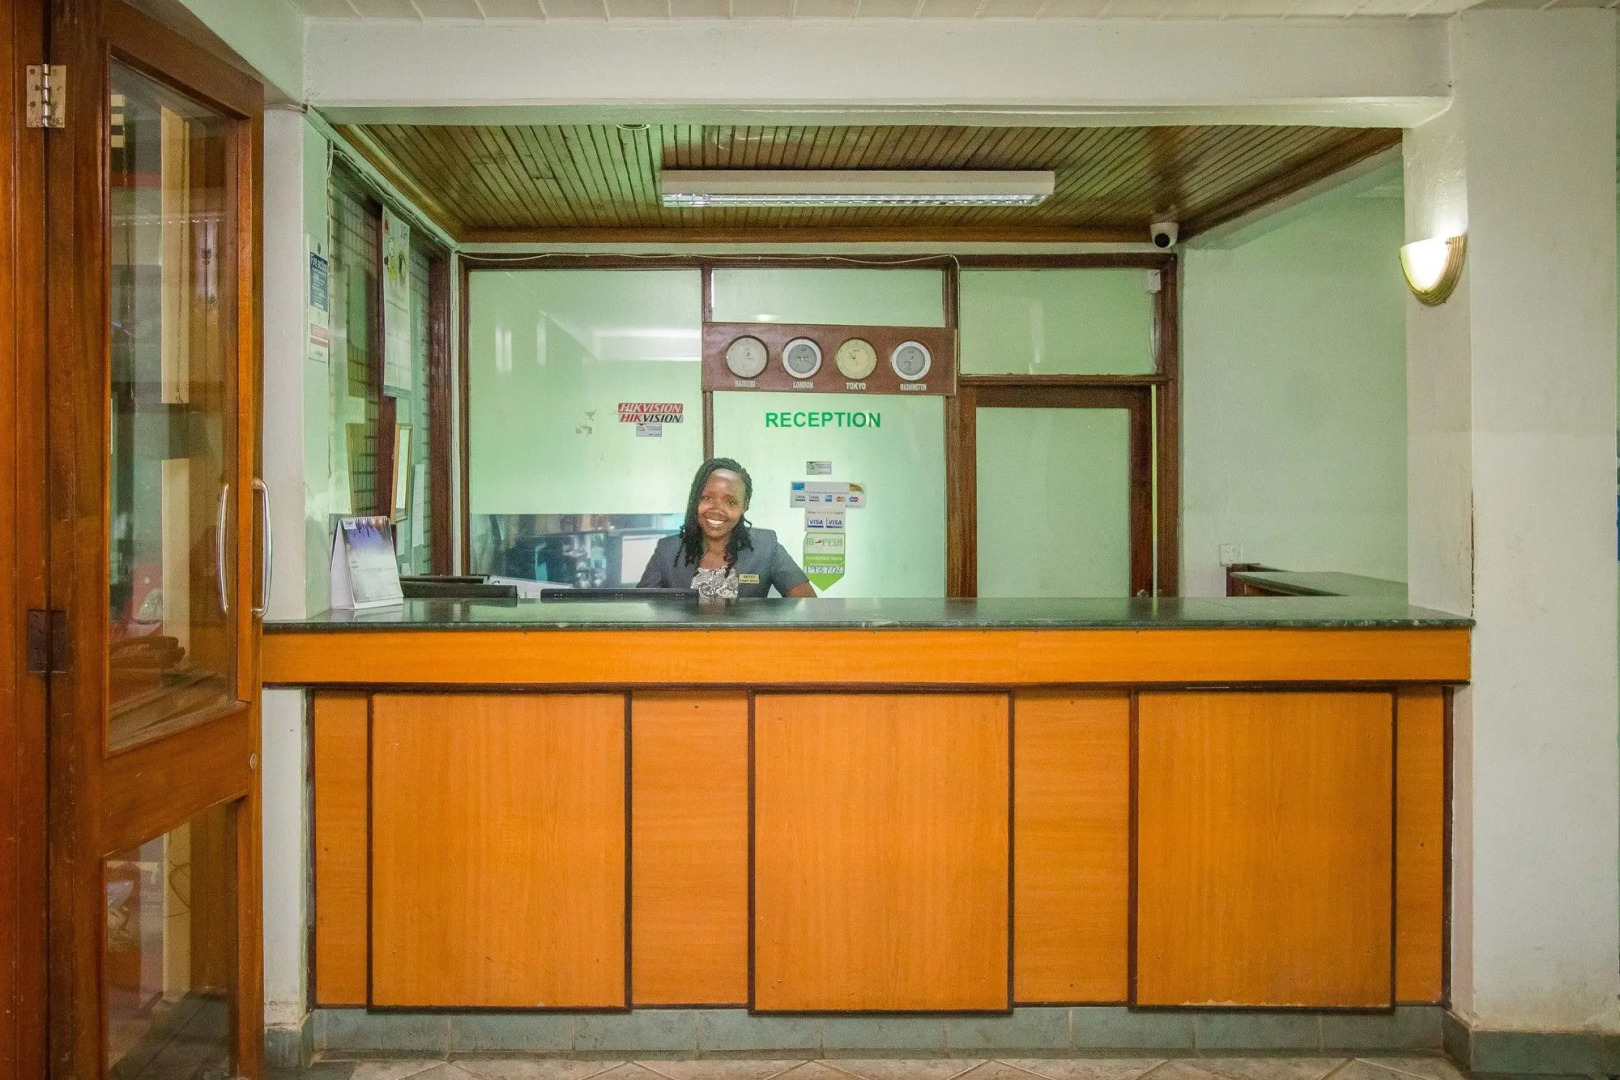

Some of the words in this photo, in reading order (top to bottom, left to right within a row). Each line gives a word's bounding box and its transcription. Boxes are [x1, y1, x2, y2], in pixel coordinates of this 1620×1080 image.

[792, 381, 814, 389] LONDON
[845, 382, 867, 390] TOKYO
[619, 403, 682, 413] HIKVISION
[620, 413, 682, 423] HIKVISION
[765, 411, 881, 428] RECEPTION
